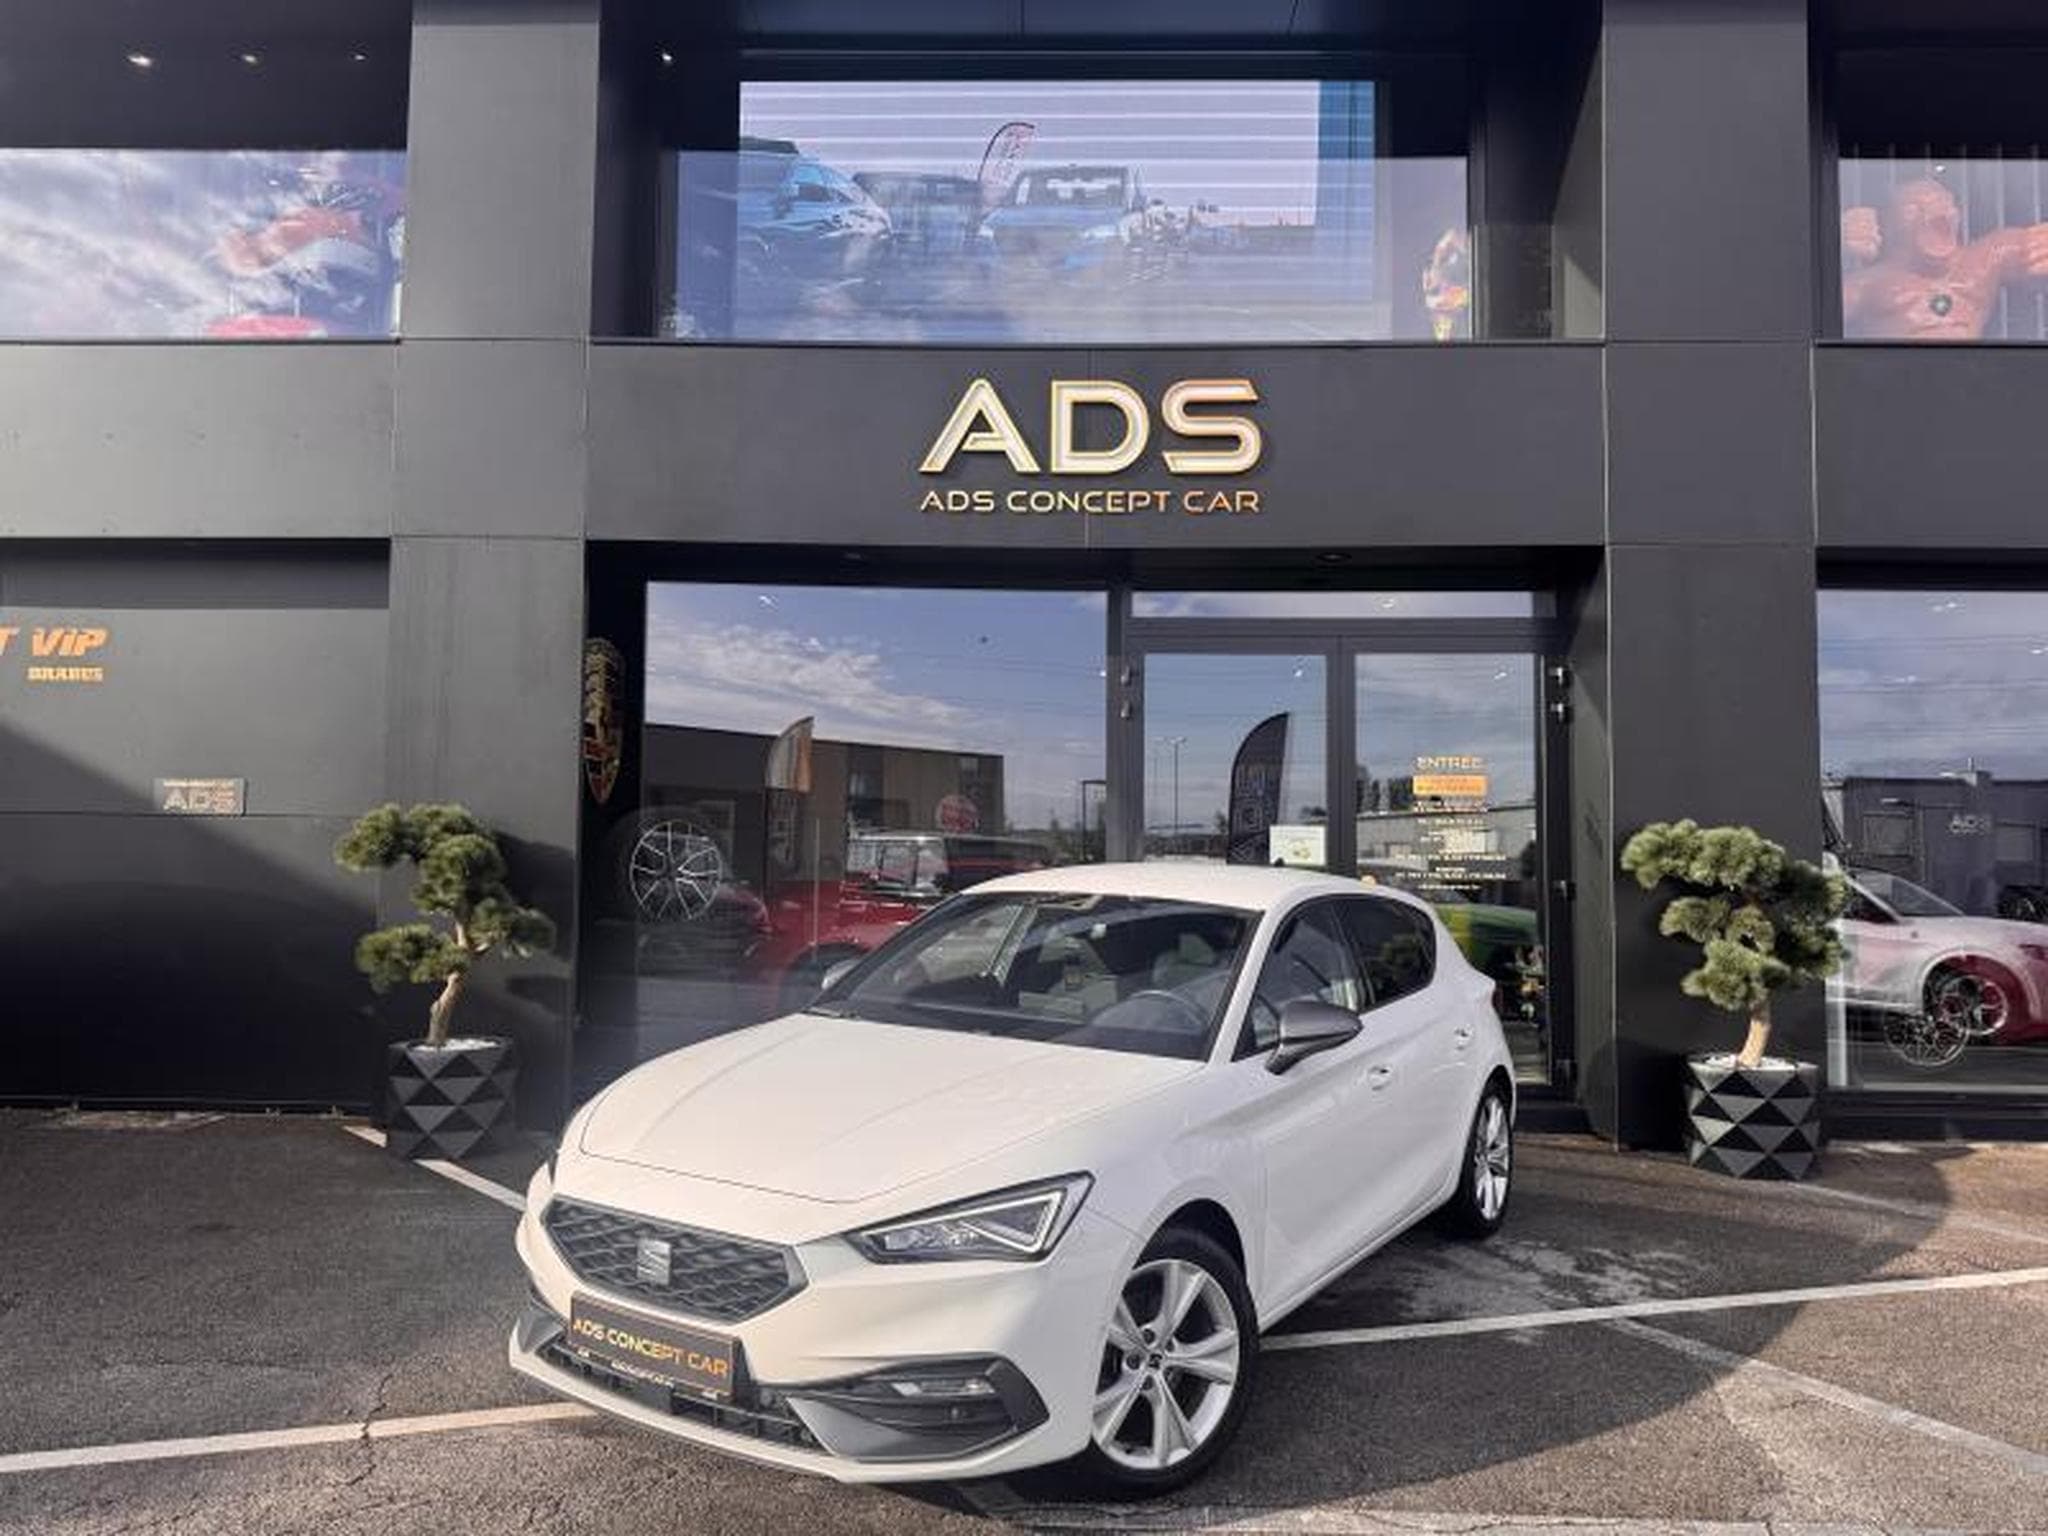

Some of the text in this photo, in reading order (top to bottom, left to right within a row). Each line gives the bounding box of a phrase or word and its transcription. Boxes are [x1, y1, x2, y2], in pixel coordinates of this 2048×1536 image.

[919, 377, 1263, 475] ADS
[920, 490, 1261, 513] ADS CONCEPT CAR
[573, 1318, 605, 1341] ADS
[607, 1328, 684, 1364] CONCEPT
[687, 1352, 729, 1377] CAR
